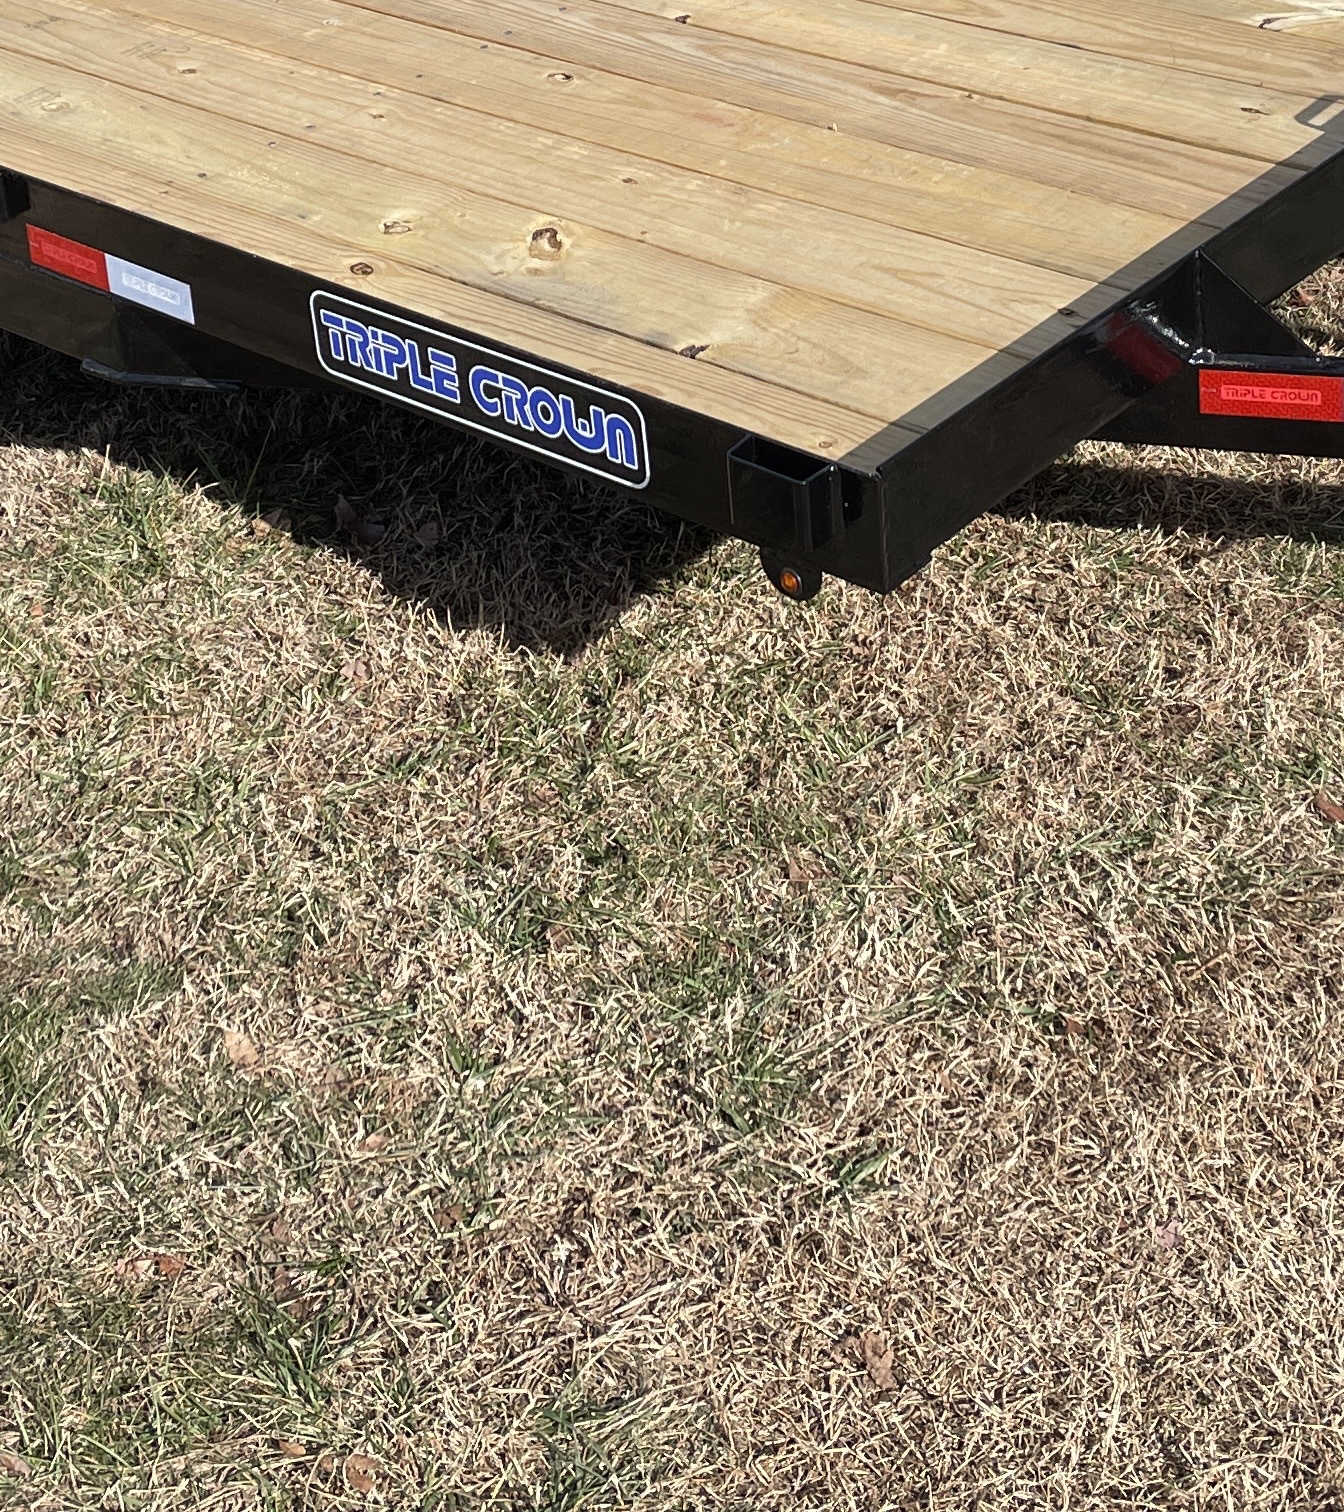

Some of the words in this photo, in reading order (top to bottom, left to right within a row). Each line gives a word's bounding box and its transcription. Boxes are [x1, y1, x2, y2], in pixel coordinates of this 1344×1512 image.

[319, 308, 461, 403] TRIPLE
[468, 365, 639, 470] CROWN
[1270, 390, 1319, 403] CROWN
